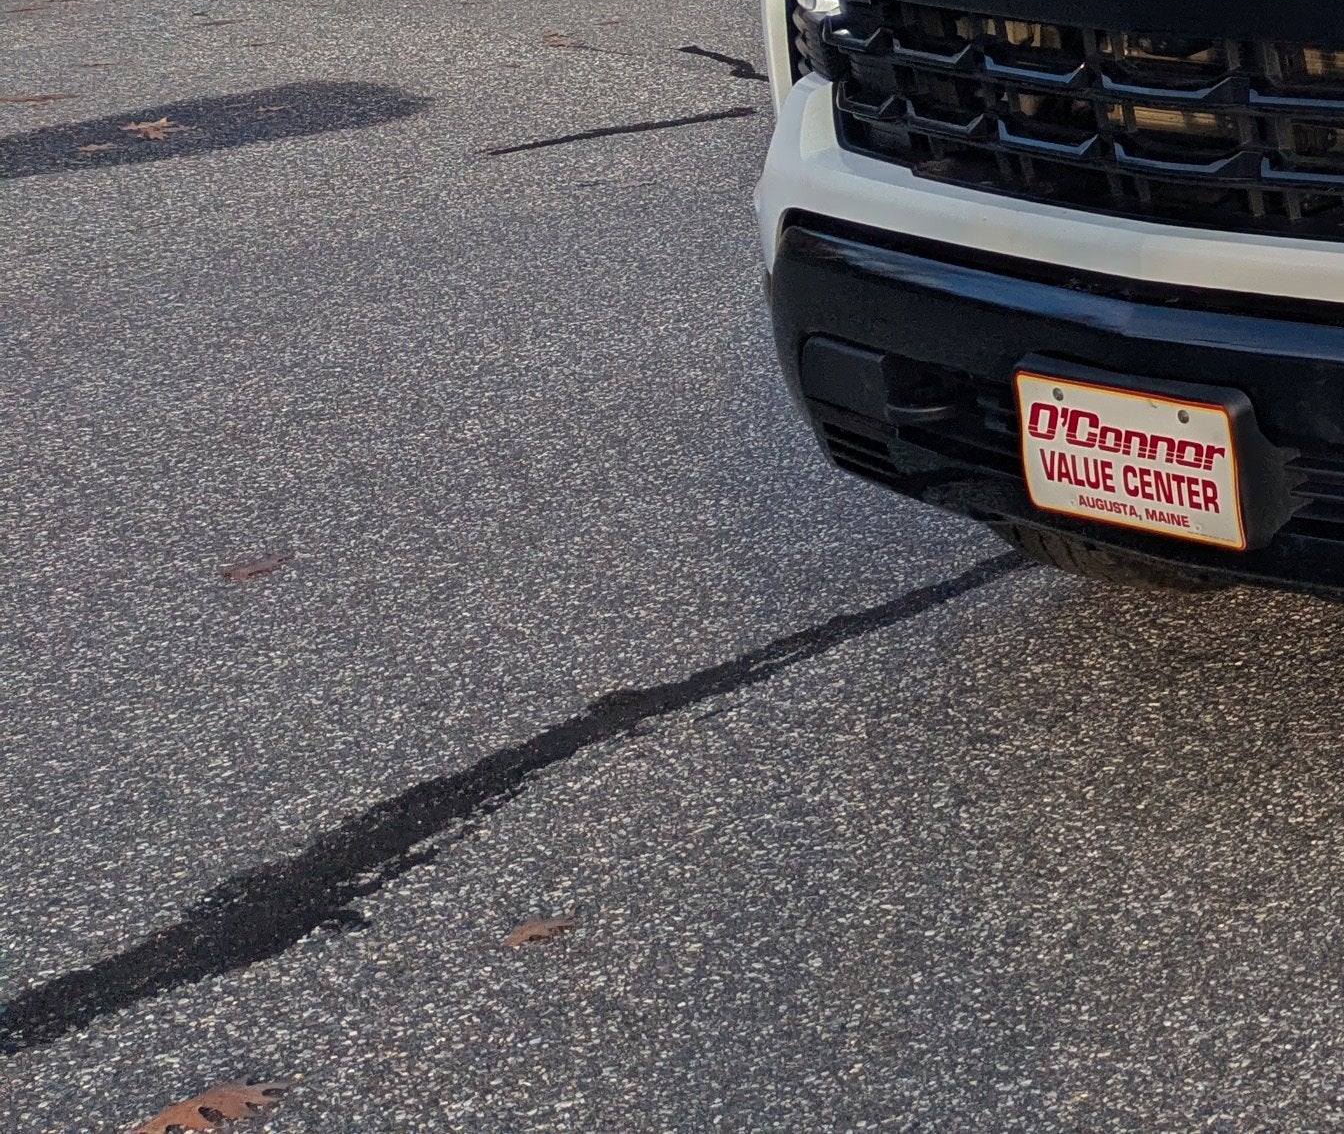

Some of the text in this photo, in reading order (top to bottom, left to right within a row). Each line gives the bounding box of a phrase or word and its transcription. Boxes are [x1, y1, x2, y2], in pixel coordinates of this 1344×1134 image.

[1028, 402, 1225, 470] O'Connor
[1040, 449, 1220, 514] VALUE CENTER
[1078, 494, 1190, 528] AUGUSTA, MAINE
